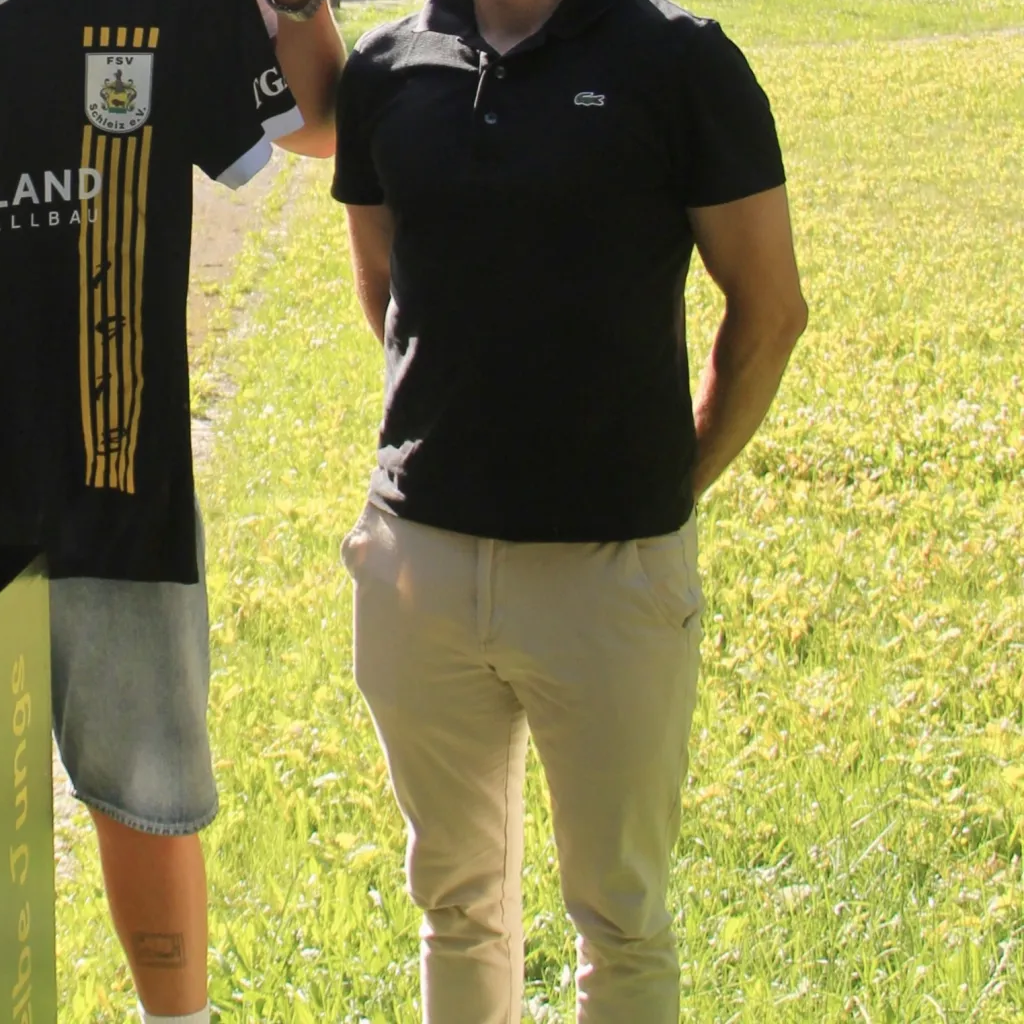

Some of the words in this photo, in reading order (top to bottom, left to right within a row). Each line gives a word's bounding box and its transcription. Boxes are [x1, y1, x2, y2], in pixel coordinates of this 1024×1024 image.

[106, 56, 134, 65] FSV
[89, 103, 125, 129] Schleiz
[129, 107, 147, 126] e.V.
[9, 654, 31, 886] Jungs
